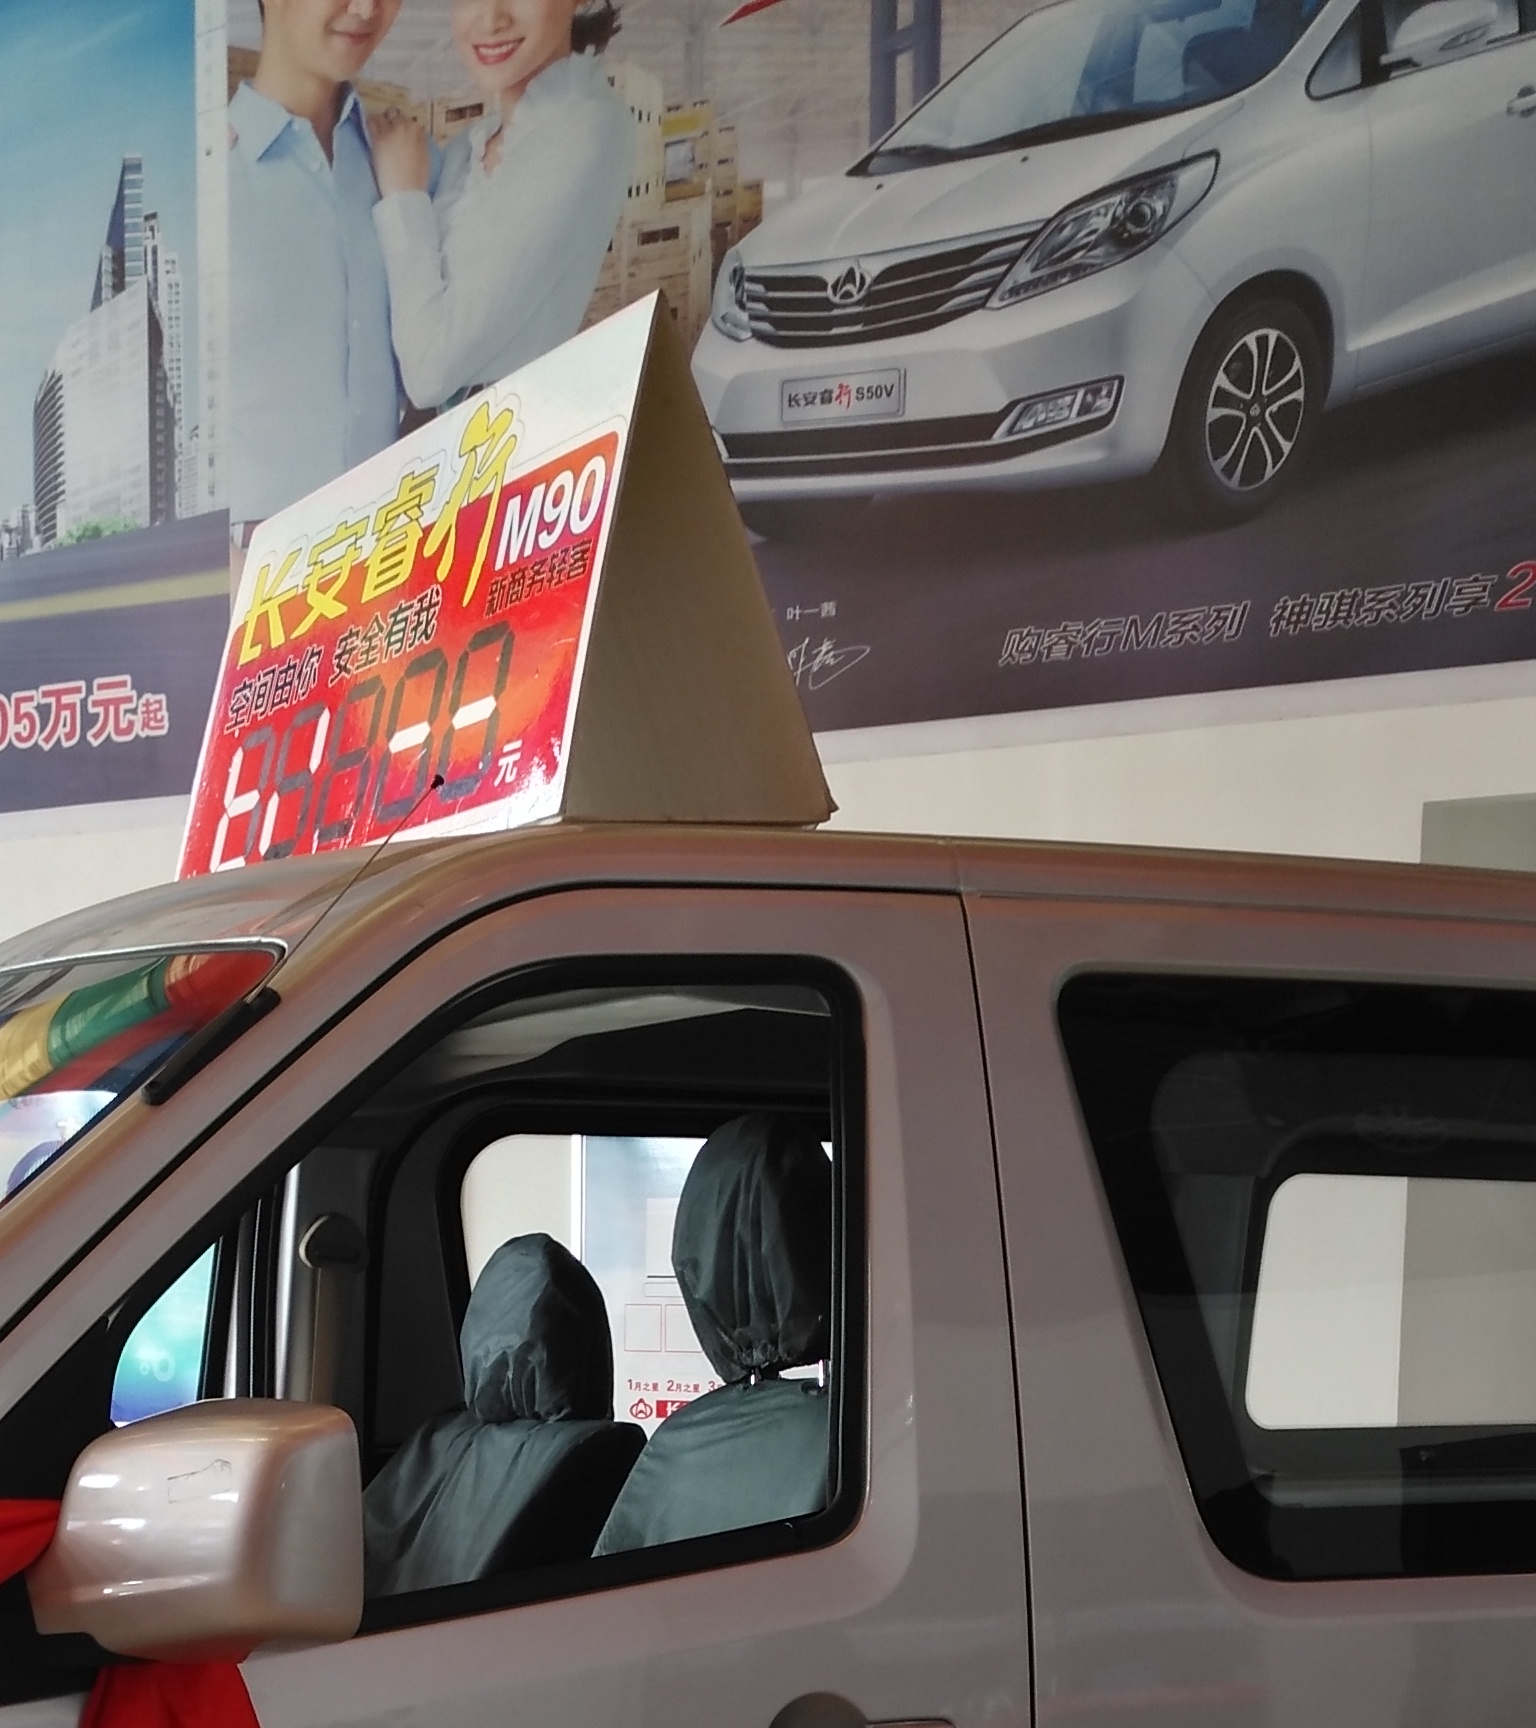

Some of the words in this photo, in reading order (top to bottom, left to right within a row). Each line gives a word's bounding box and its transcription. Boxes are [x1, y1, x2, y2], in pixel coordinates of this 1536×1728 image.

[855, 383, 895, 401] S50V
[238, 402, 518, 668] 长安睿行
[493, 454, 607, 571] M90
[484, 539, 594, 619] 新商务轻客
[224, 644, 324, 735] 空间由你
[329, 583, 443, 687] 安全有我
[997, 600, 1251, 667] 购睿行M系列
[626, 1378, 659, 1392] 1月之星
[666, 1379, 700, 1393] 2月之星
